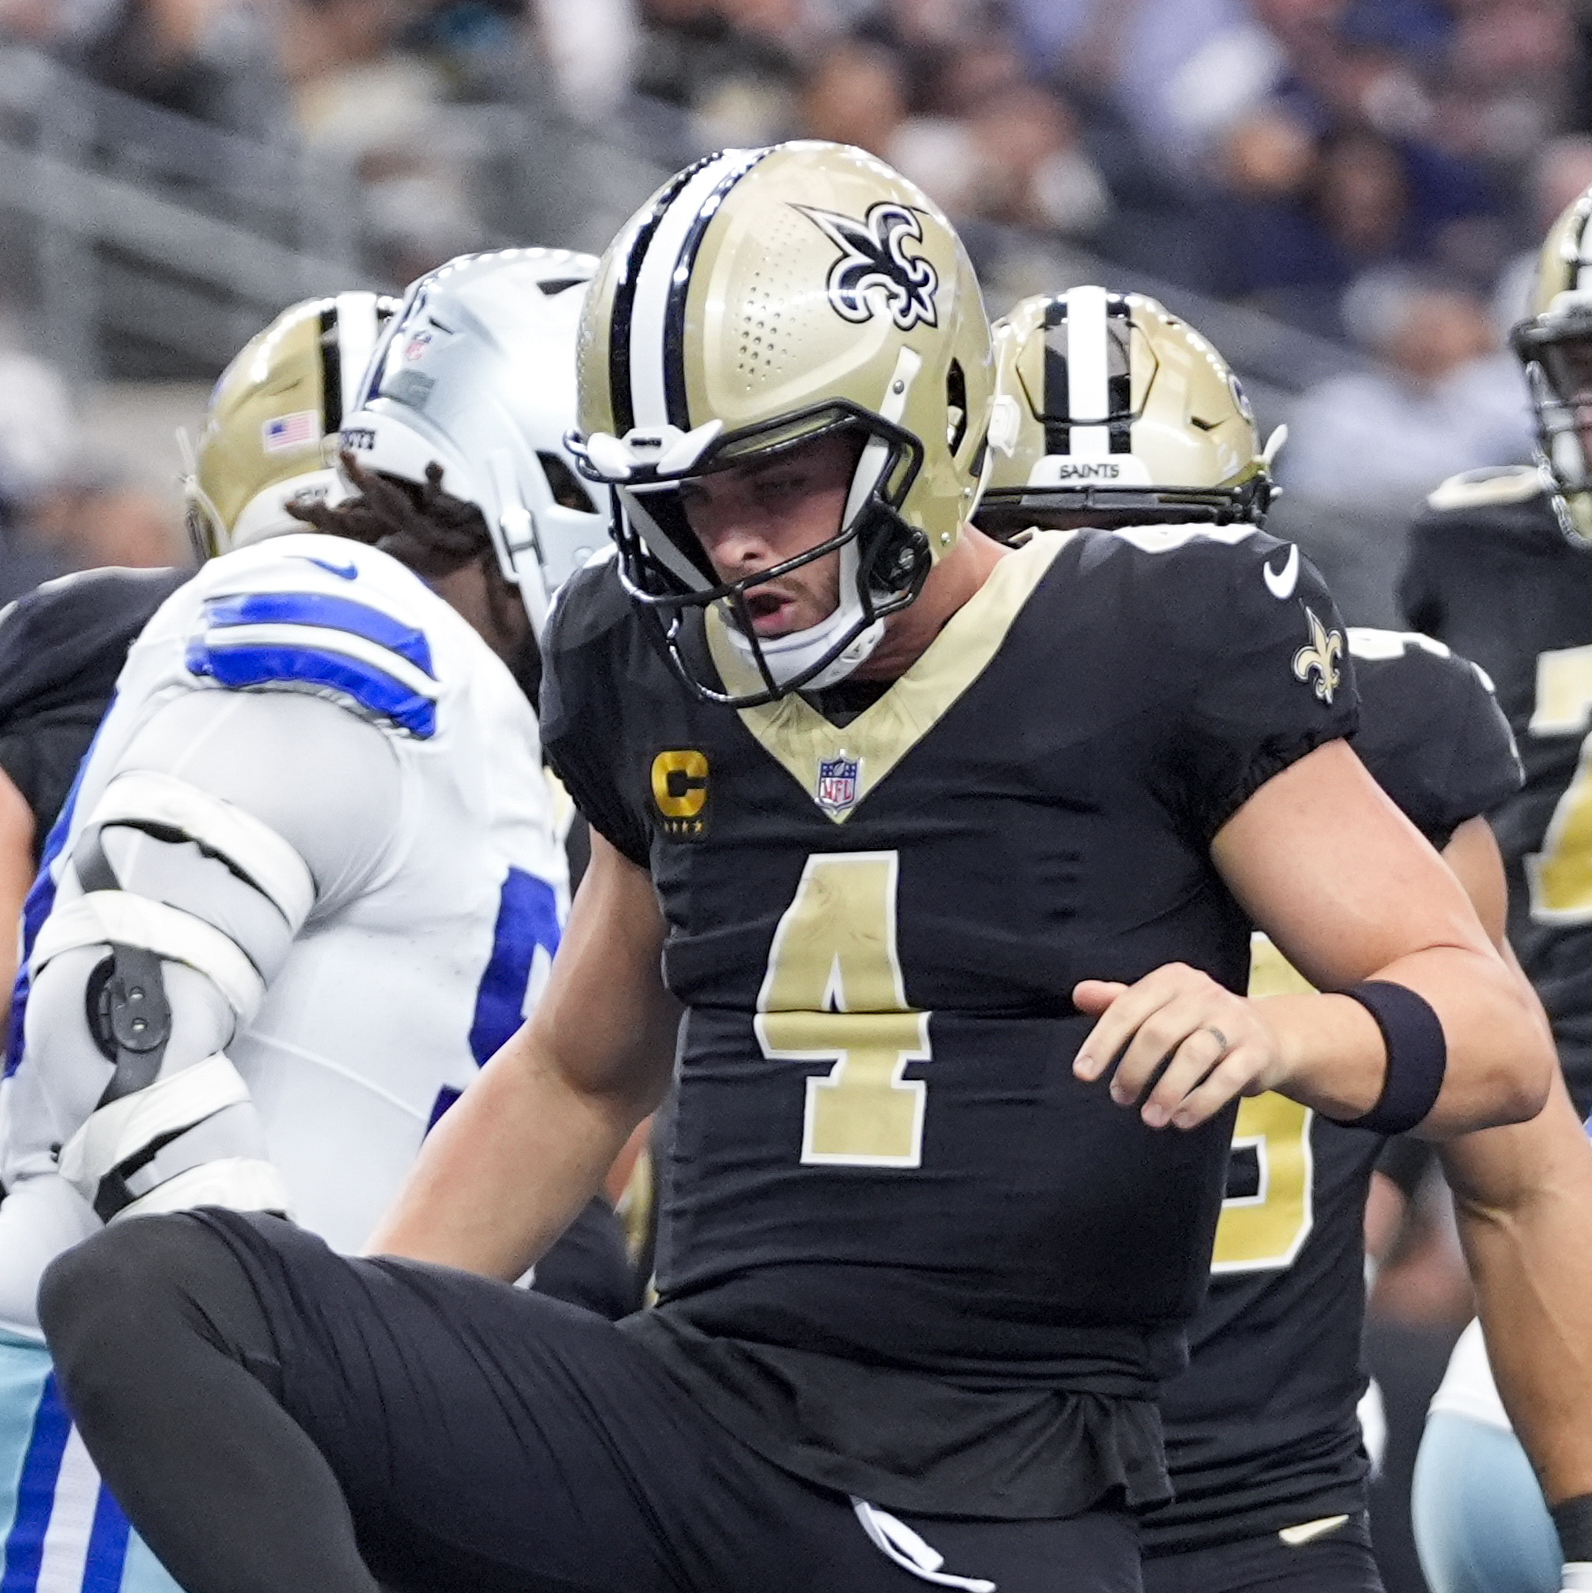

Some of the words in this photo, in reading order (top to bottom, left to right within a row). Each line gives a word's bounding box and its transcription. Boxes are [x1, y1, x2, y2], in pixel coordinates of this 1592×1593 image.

[1059, 463, 1120, 480] SAINTS
[651, 749, 709, 817] C
[820, 779, 853, 803] NFL
[753, 850, 933, 1168] 4
